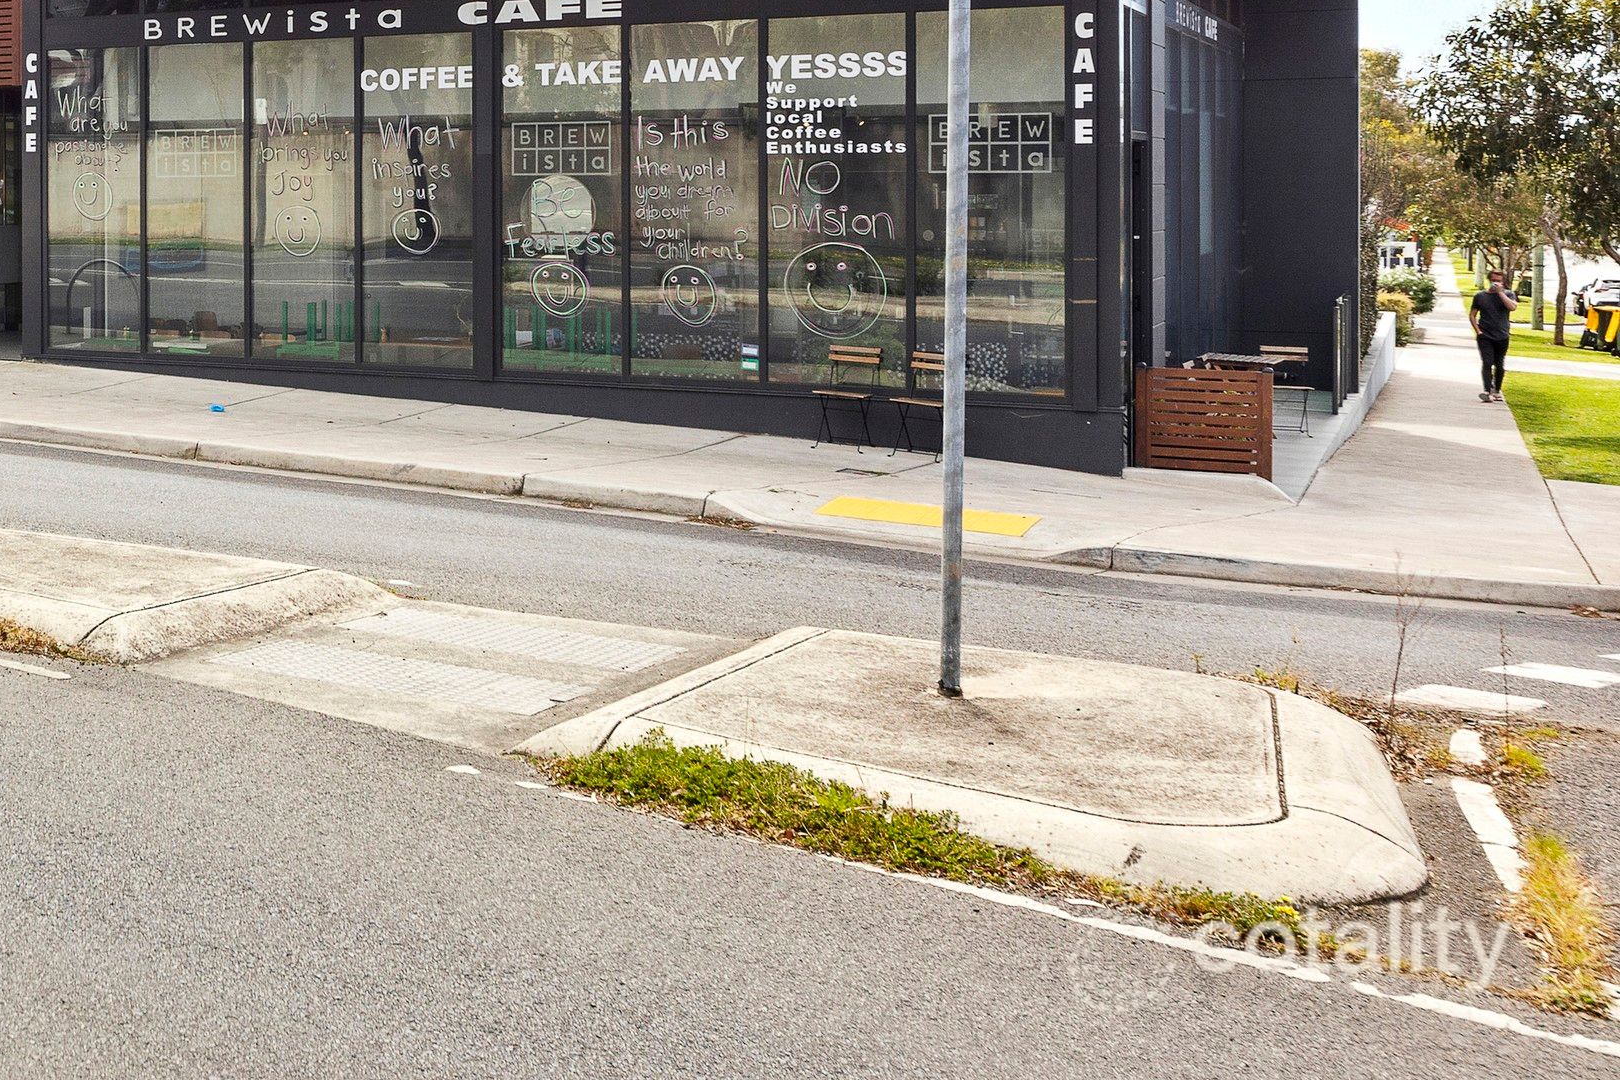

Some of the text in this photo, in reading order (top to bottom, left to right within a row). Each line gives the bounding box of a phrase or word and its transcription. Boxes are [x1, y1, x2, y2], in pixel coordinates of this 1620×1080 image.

[144, 8, 402, 40] BREWista
[360, 51, 907, 92] COFFEE & TAKE AWAY YESSSS
[1073, 12, 1095, 144] CAFE
[766, 81, 797, 94] We
[25, 52, 38, 153] CAFE
[58, 85, 113, 118] What
[766, 94, 858, 111] Support
[71, 117, 128, 140] are you
[266, 100, 332, 137] What
[766, 110, 822, 124] local
[939, 121, 1045, 138] BREW
[162, 135, 232, 150] BREW
[378, 114, 459, 153] What
[520, 128, 605, 145] BREW
[638, 114, 730, 151] Is this
[766, 126, 841, 139] Coffee
[260, 141, 348, 171] brings you
[766, 140, 907, 154] Enthusiasts
[371, 158, 451, 187] inspires
[522, 153, 605, 170] ista
[634, 156, 727, 182] the world
[272, 170, 314, 202] Joy
[779, 157, 841, 197] NO
[392, 183, 438, 209] you?
[531, 178, 584, 219] Be
[635, 183, 734, 205] you dream
[635, 199, 734, 221] about for
[640, 225, 685, 248] your
